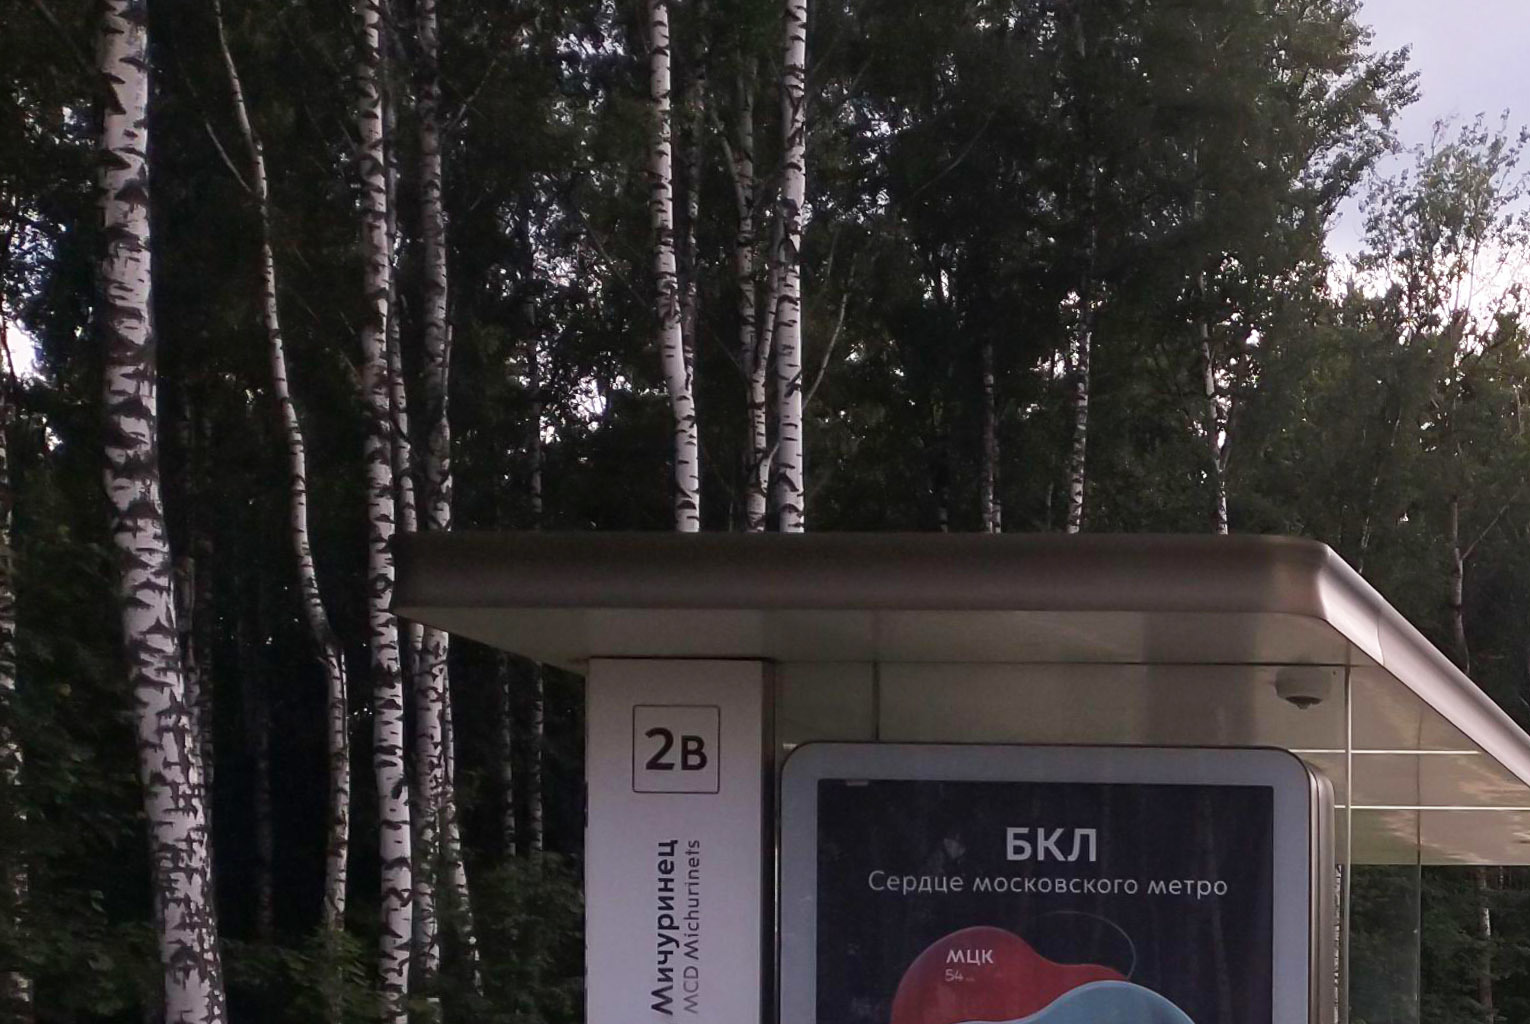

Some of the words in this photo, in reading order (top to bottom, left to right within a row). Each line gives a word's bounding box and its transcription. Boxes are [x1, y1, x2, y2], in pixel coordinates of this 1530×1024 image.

[1006, 827, 1097, 862] БКЛ
[682, 840, 700, 960] Michurinets
[868, 870, 964, 895] Сердце
[972, 875, 1139, 895] московского
[1147, 878, 1229, 900] метро
[650, 839, 679, 1016] Мичуринец
[944, 968, 964, 982] 54
[945, 949, 994, 966] МЦК
[682, 965, 700, 1014] MCD
